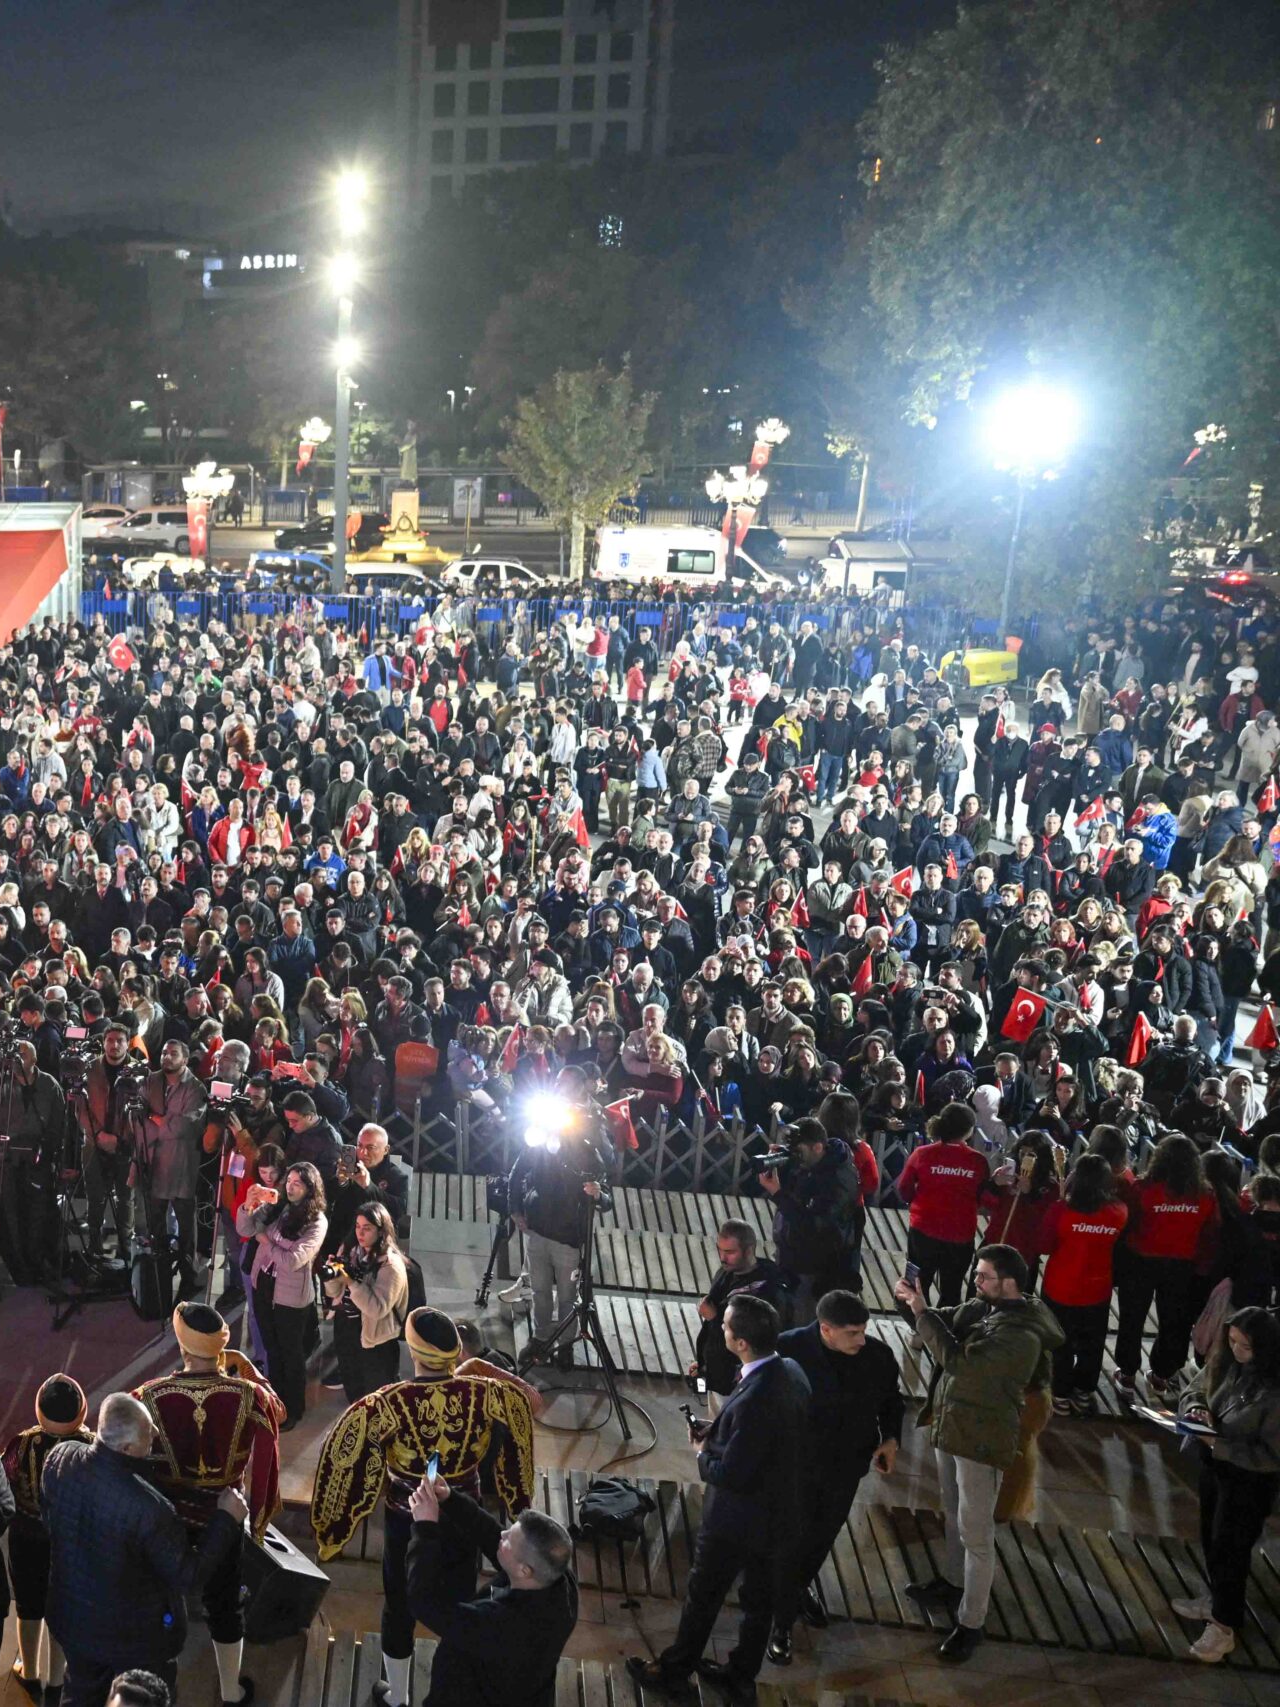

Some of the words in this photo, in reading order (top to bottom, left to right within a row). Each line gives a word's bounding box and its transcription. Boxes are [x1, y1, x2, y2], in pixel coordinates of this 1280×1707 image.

[930, 1165, 975, 1178] TÜRKİYE
[1154, 1203, 1200, 1214] TÜRKİYE
[1072, 1222, 1117, 1235] TÜRKİYE
